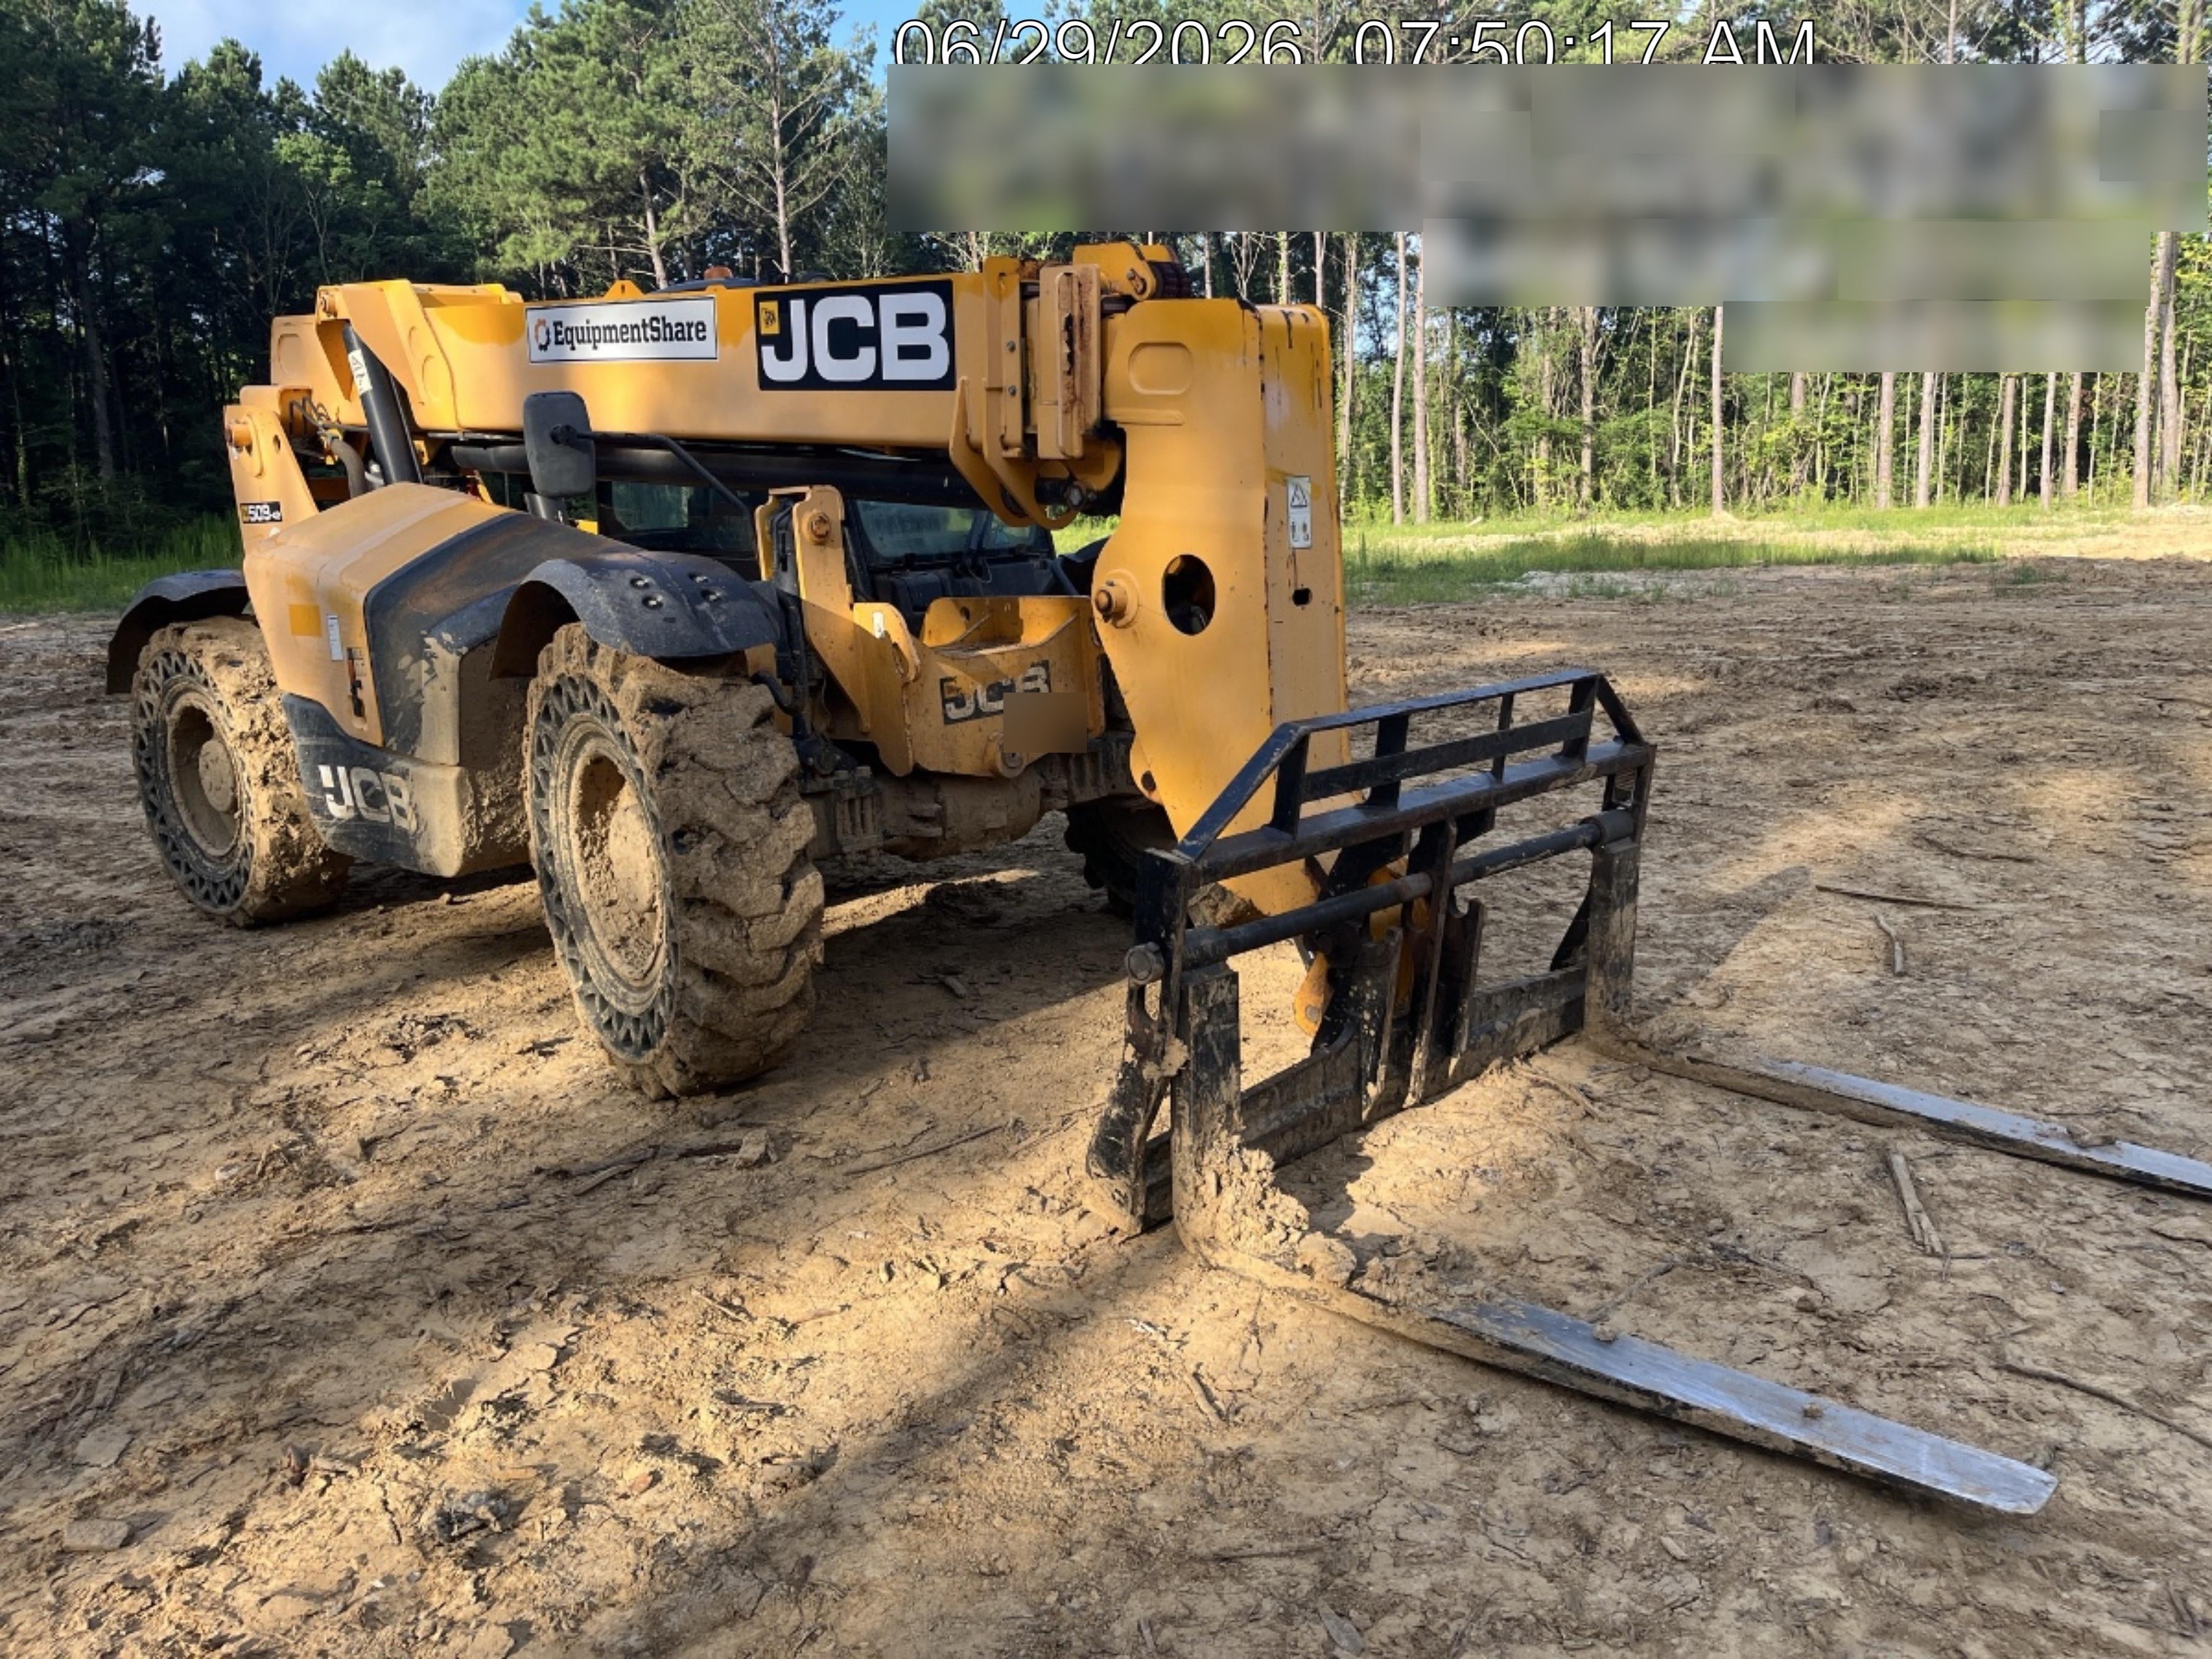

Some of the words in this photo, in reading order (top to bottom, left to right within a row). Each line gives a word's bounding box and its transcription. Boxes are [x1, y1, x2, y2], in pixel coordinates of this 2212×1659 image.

[553, 315, 707, 351] EquipmentShare
[761, 292, 950, 382] JCB
[322, 765, 419, 833] JCB
